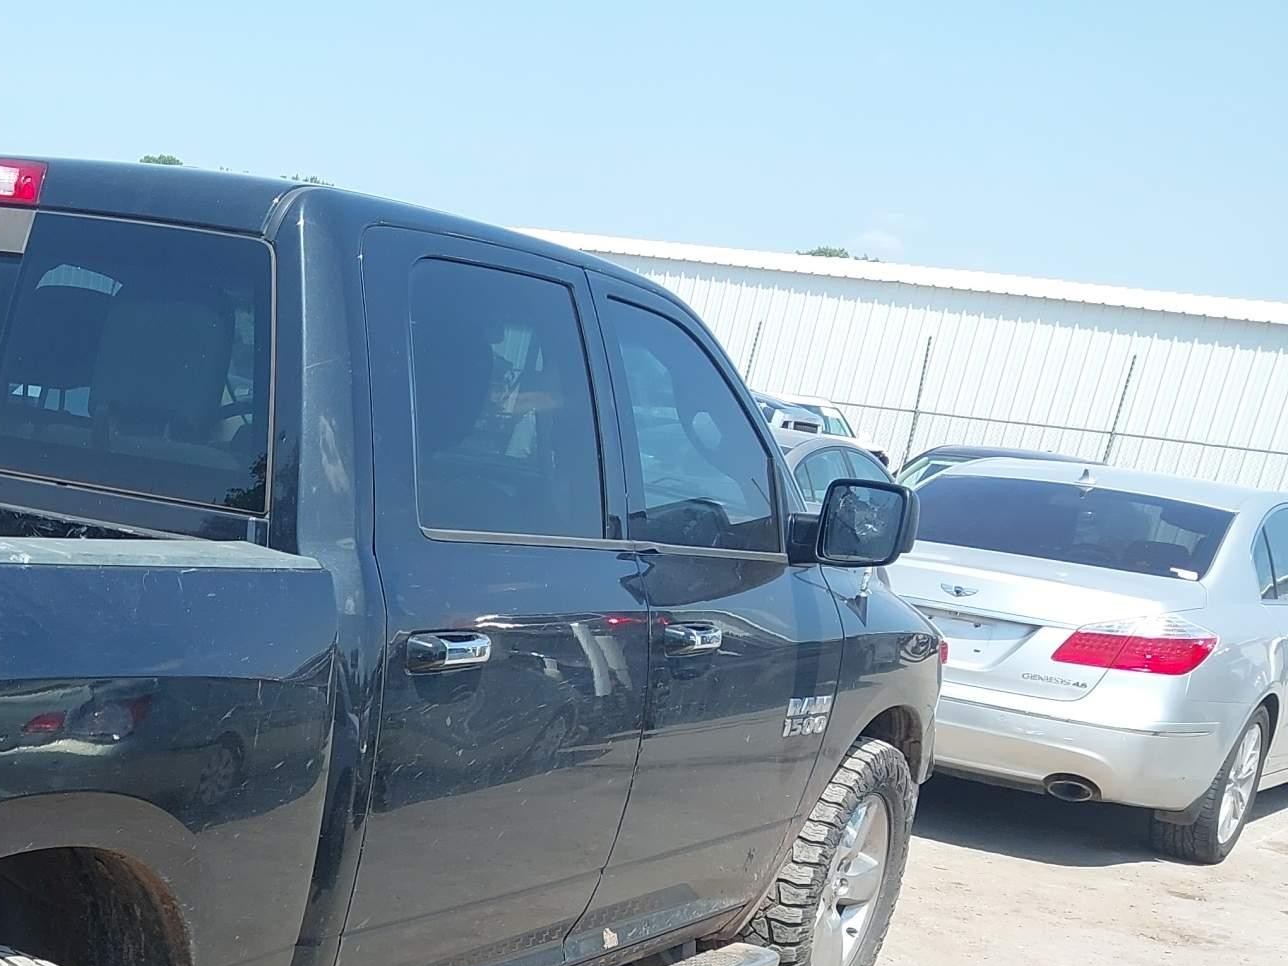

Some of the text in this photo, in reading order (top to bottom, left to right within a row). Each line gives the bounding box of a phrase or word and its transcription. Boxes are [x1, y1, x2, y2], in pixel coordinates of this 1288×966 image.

[1022, 672, 1072, 686] GENESIS
[787, 695, 833, 717] RAM
[782, 715, 828, 738] 1500
